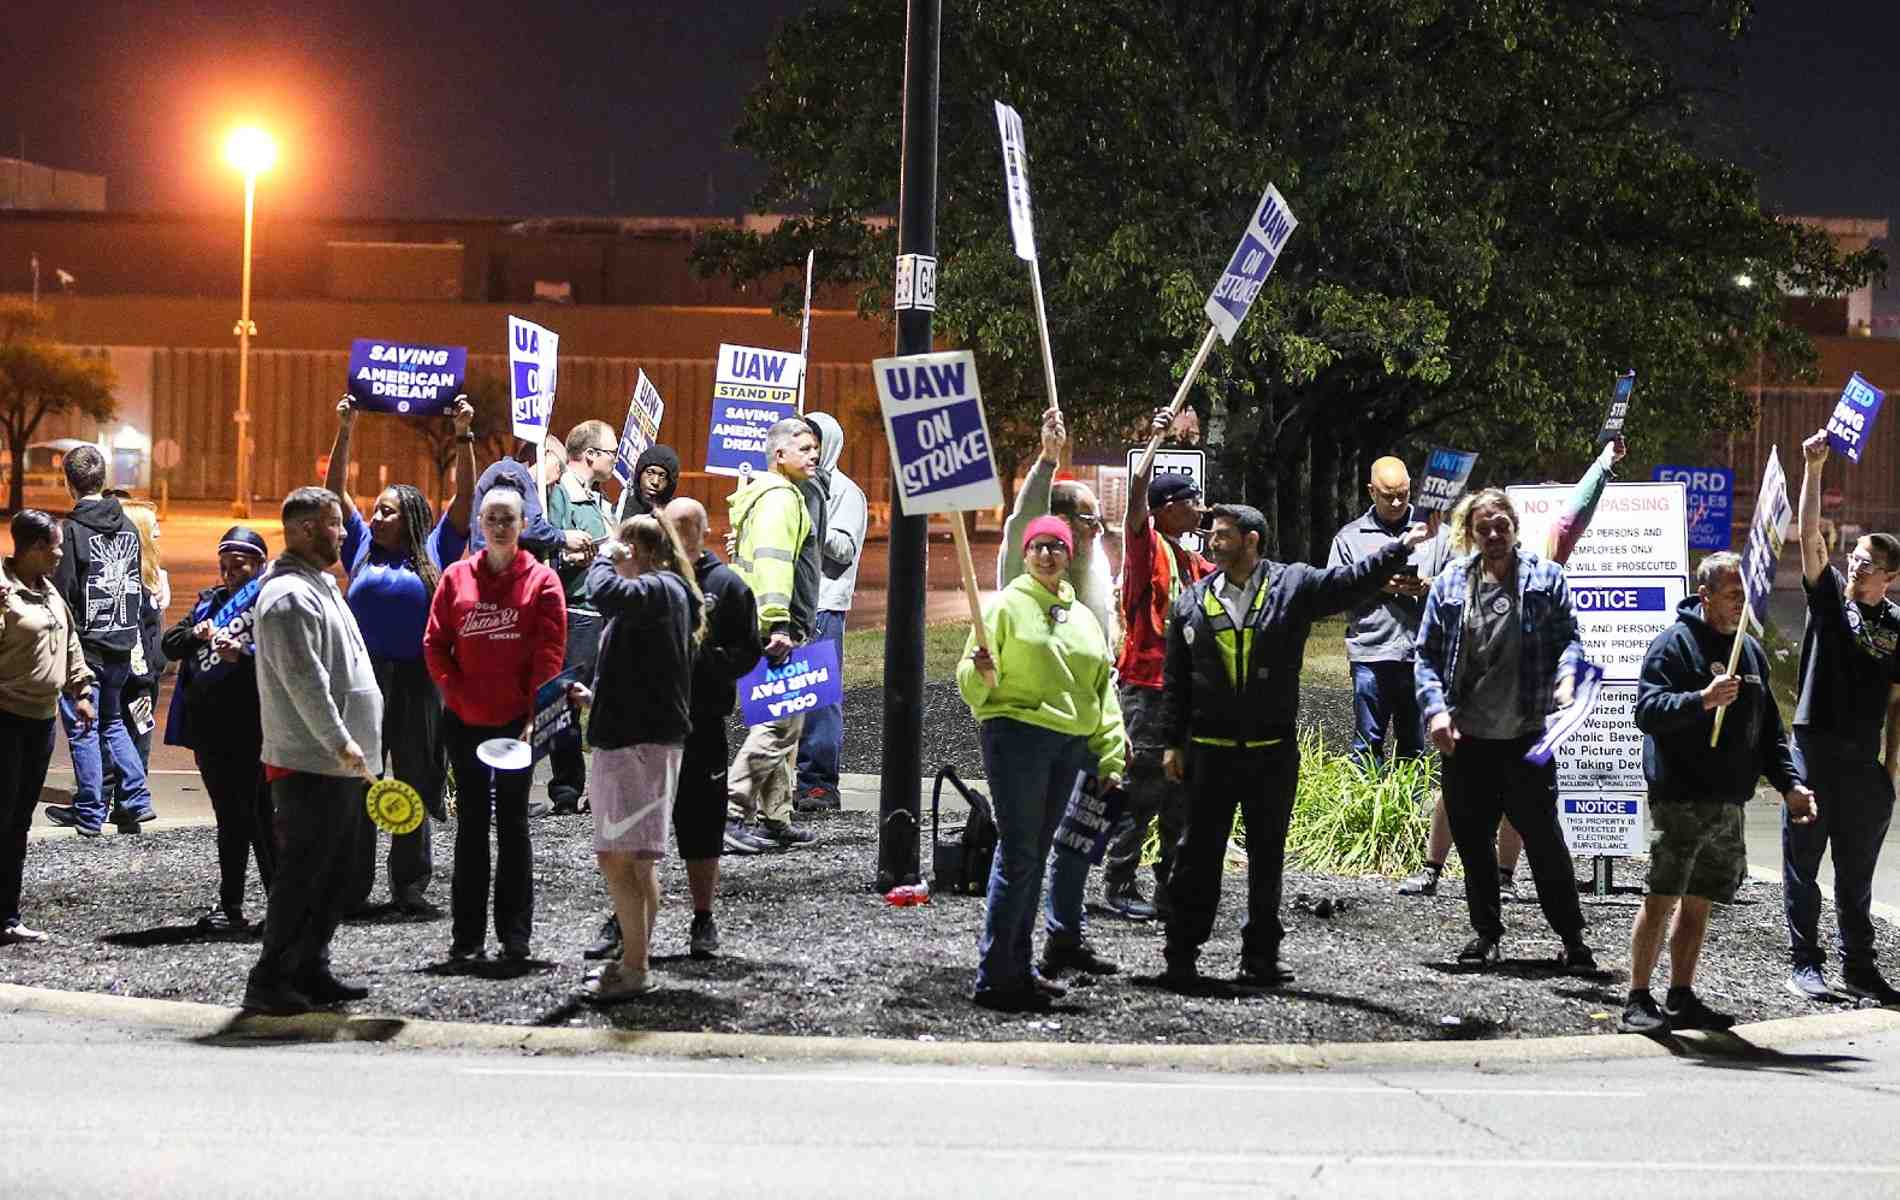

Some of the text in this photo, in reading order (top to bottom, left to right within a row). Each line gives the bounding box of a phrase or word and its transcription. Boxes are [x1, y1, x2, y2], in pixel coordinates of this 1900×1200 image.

[1258, 196, 1289, 250] UAW
[1241, 248, 1265, 275] ON
[1215, 272, 1260, 303] STRIKE
[515, 325, 539, 354] UA
[369, 345, 448, 366] SAVING
[732, 350, 787, 382] UAW
[357, 366, 455, 387] AMERICAN
[886, 362, 965, 401] UAW
[372, 382, 437, 399] DREAM
[720, 386, 791, 401] STAND UP
[640, 379, 660, 419] UAW
[725, 407, 779, 423] SAVING
[712, 423, 768, 438] AMERIC
[917, 409, 953, 450] ON
[902, 428, 988, 494] STRIKE
[1660, 470, 1726, 492] FORD
[1524, 500, 1549, 513] NO
[1690, 494, 1727, 508] CLES
[1596, 528, 1640, 538] PERSONS
[1644, 528, 1661, 536] AND
[1573, 544, 1654, 555] EMPLOYEES ONLY
[1576, 562, 1598, 572] WILL
[1600, 562, 1614, 571] BE
[1616, 561, 1678, 571] PROSECUTED
[1591, 624, 1612, 633] AND
[1616, 624, 1665, 633] PERSONS
[1583, 640, 1608, 648] PANY
[1600, 655, 1614, 664] TO
[766, 660, 809, 681] NOW
[751, 667, 828, 701] FAIR PAY
[768, 692, 818, 717] COLA
[1584, 719, 1638, 730] Weapons
[1568, 732, 1644, 742] oholic Bever
[1559, 745, 1641, 756] No Picture or
[1575, 759, 1613, 772] Taking
[1618, 760, 1642, 770] Dev
[1576, 801, 1626, 813] NOTICE
[1566, 816, 1636, 825] THIS PROPERTY IS
